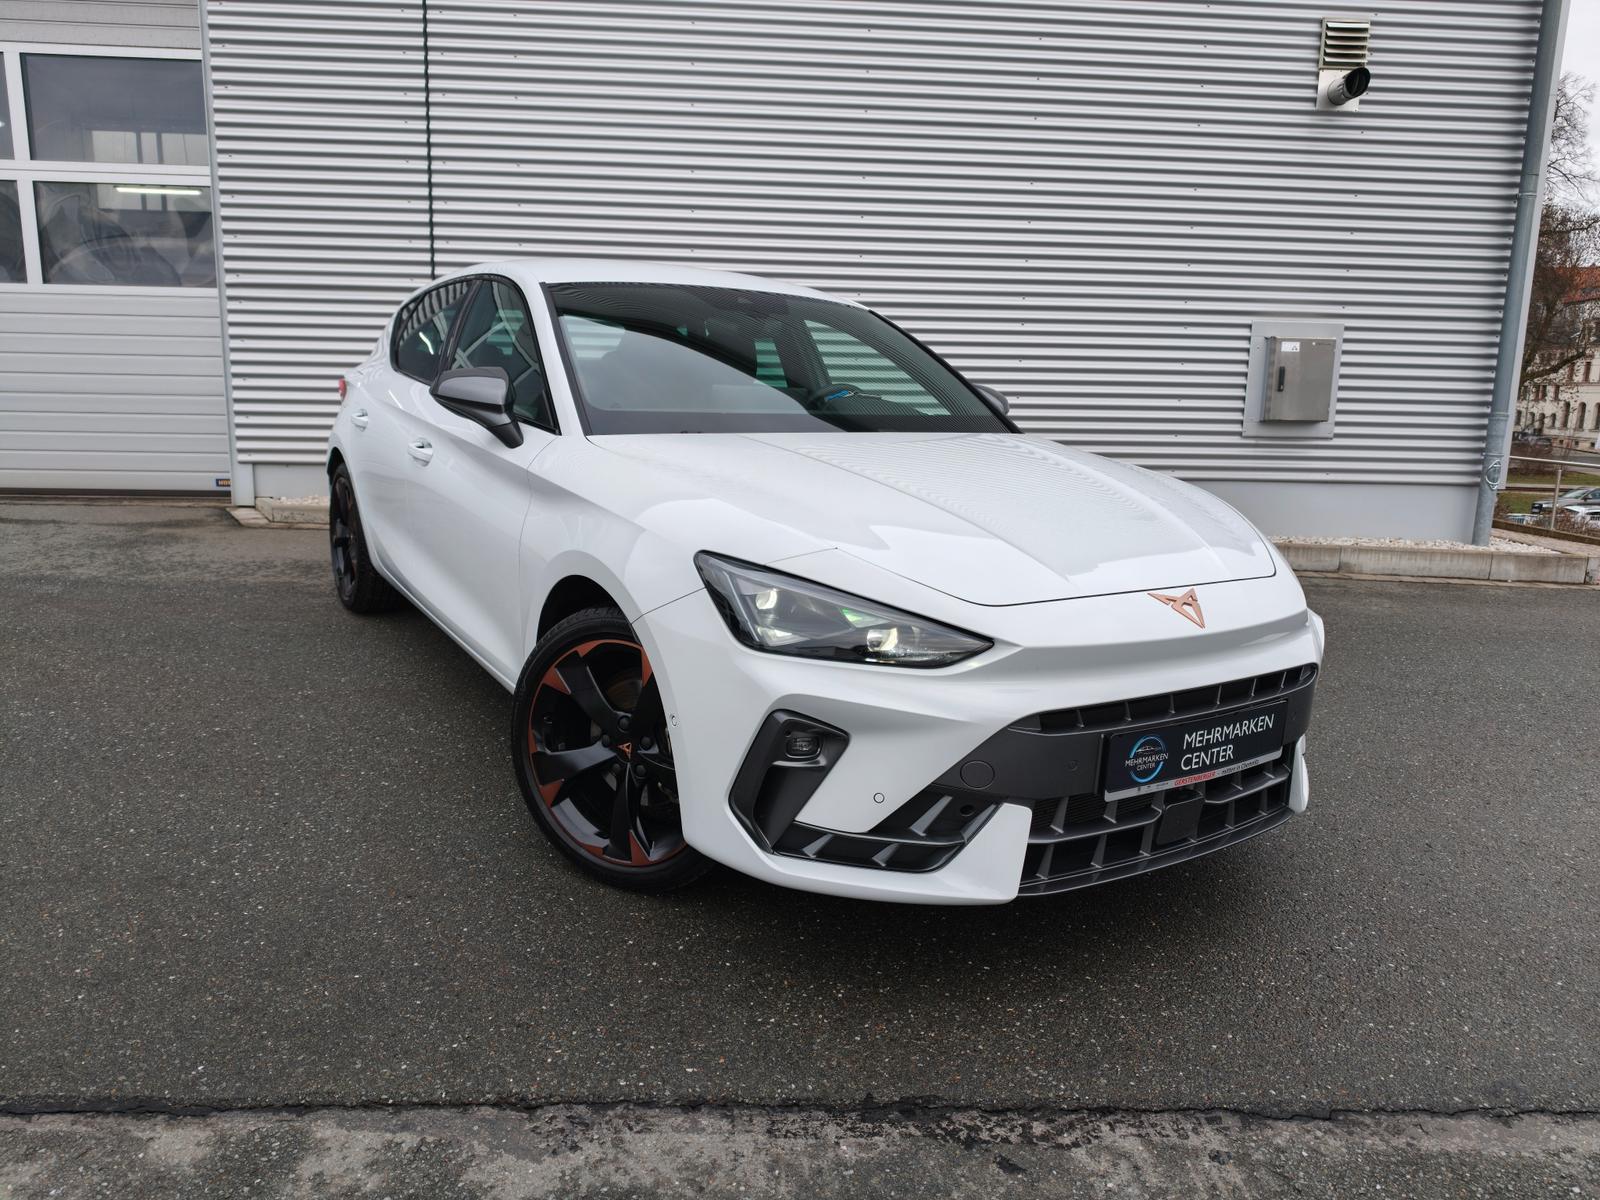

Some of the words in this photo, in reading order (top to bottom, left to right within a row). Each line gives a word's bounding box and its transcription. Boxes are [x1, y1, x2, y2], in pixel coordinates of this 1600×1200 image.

[1184, 714, 1274, 749] MEHRMARKEN
[1125, 752, 1168, 767] MEHRMARKEN
[1136, 762, 1156, 771] CENTER
[1181, 744, 1234, 770] CENTER
